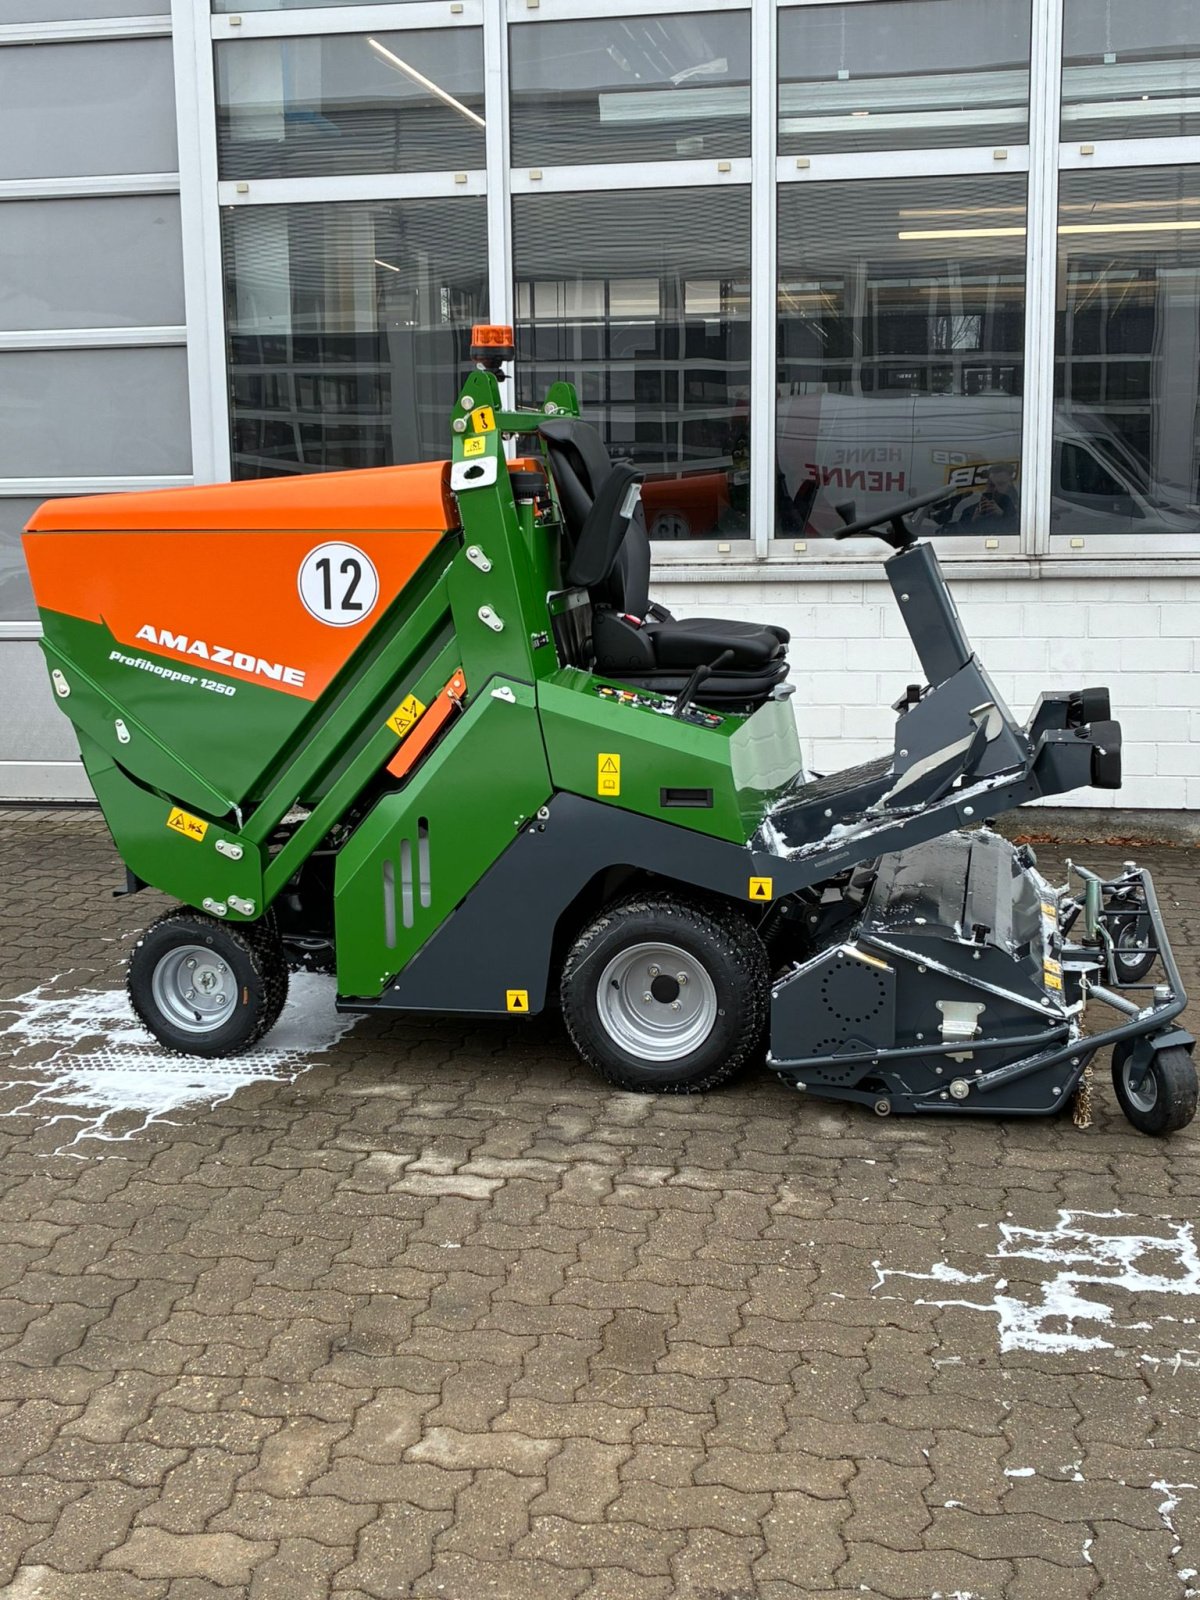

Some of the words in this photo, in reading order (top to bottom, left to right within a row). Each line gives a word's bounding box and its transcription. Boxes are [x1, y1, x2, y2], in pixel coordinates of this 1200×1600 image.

[315, 557, 363, 611] 12
[108, 650, 198, 685] Profihopper
[200, 677, 237, 697] 1250
[135, 624, 306, 688] AMAZONE
